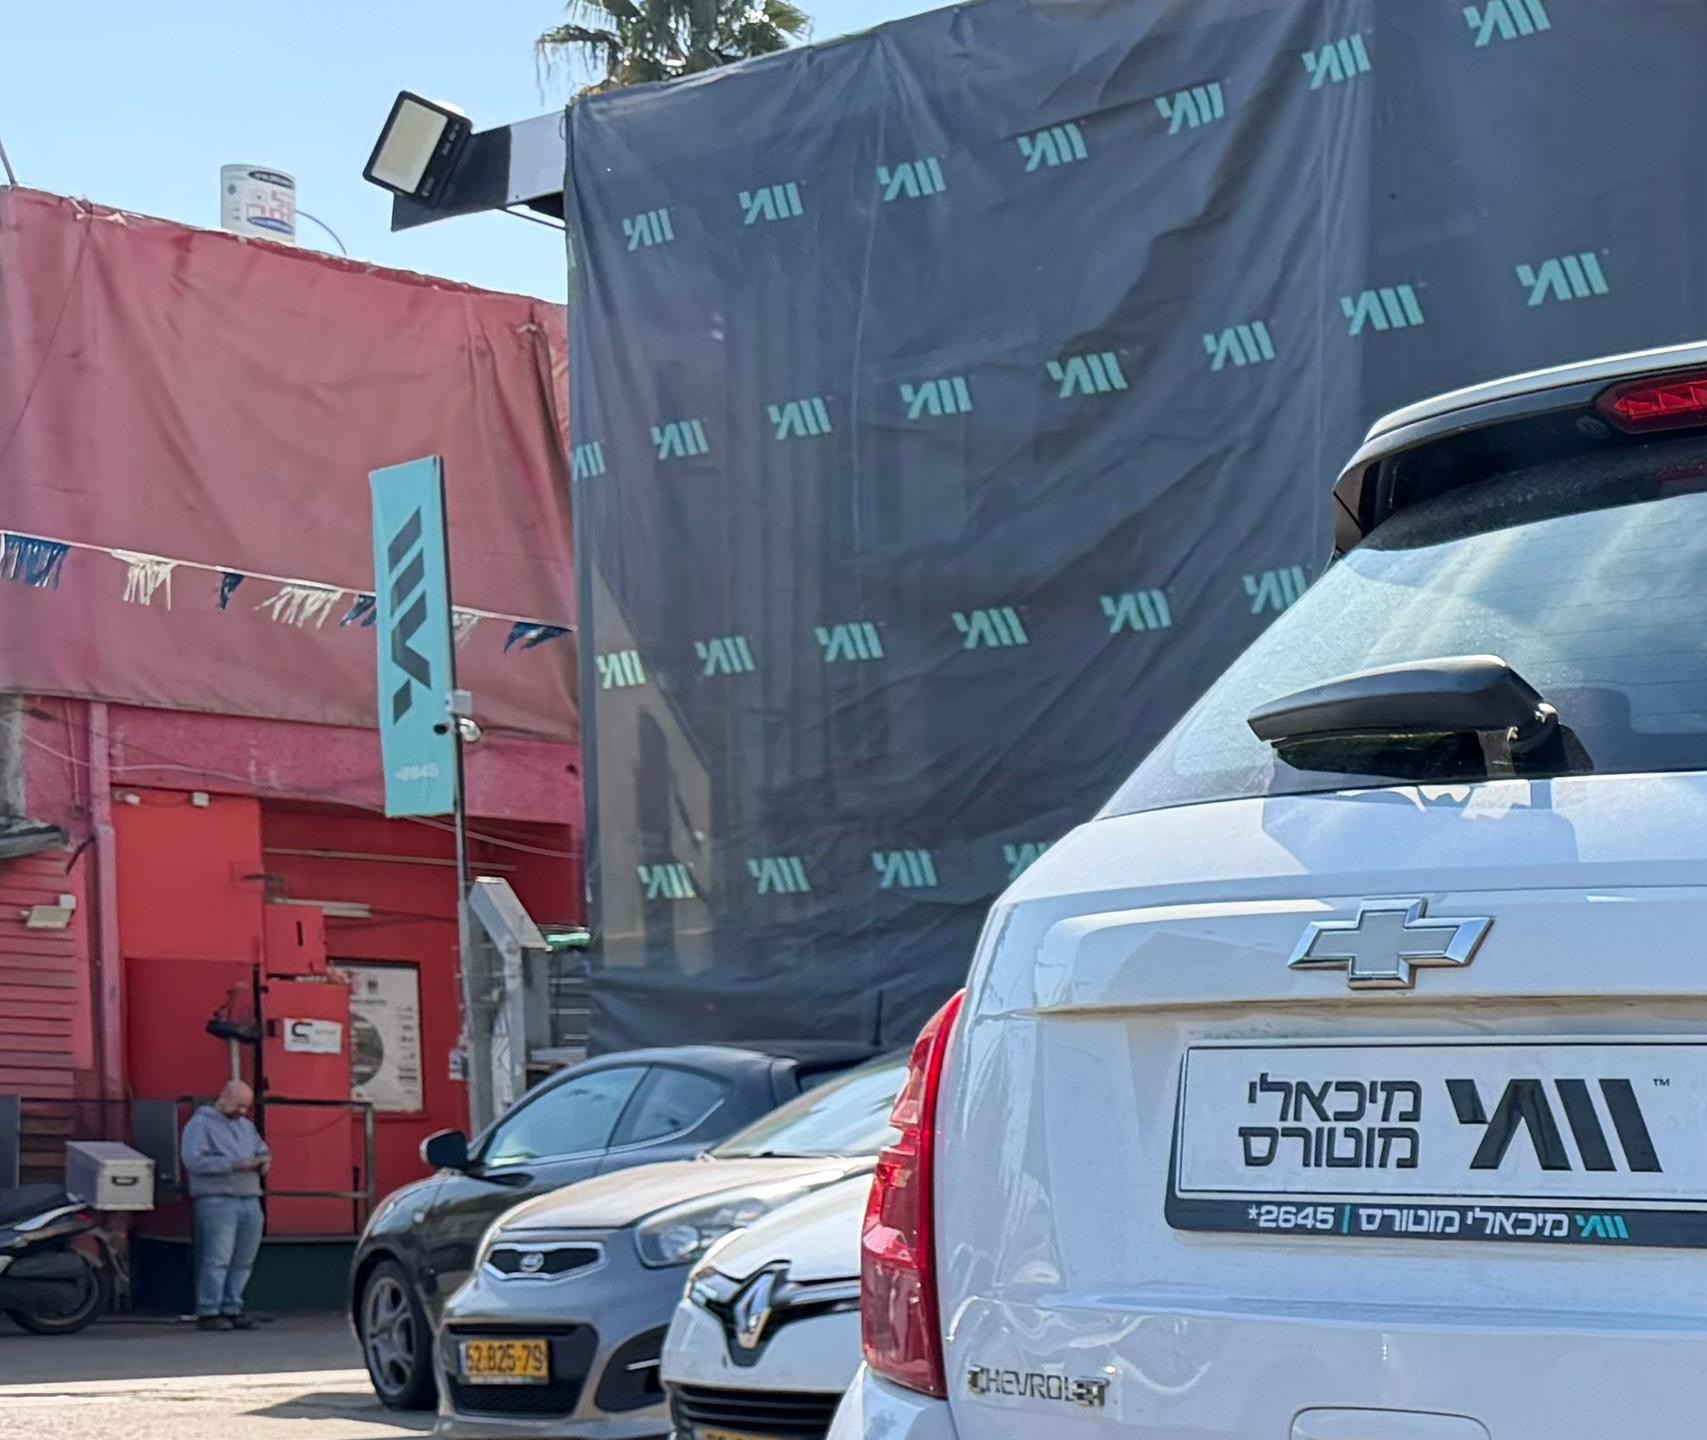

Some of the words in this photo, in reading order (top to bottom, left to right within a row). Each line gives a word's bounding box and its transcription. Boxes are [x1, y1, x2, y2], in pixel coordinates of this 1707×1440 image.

[1248, 1072, 1422, 1122] מיכאלי
[1238, 1126, 1420, 1169] מוטורס
[1358, 1207, 1460, 1233] מוטורס
[1466, 1207, 1569, 1237] מיכאלי
